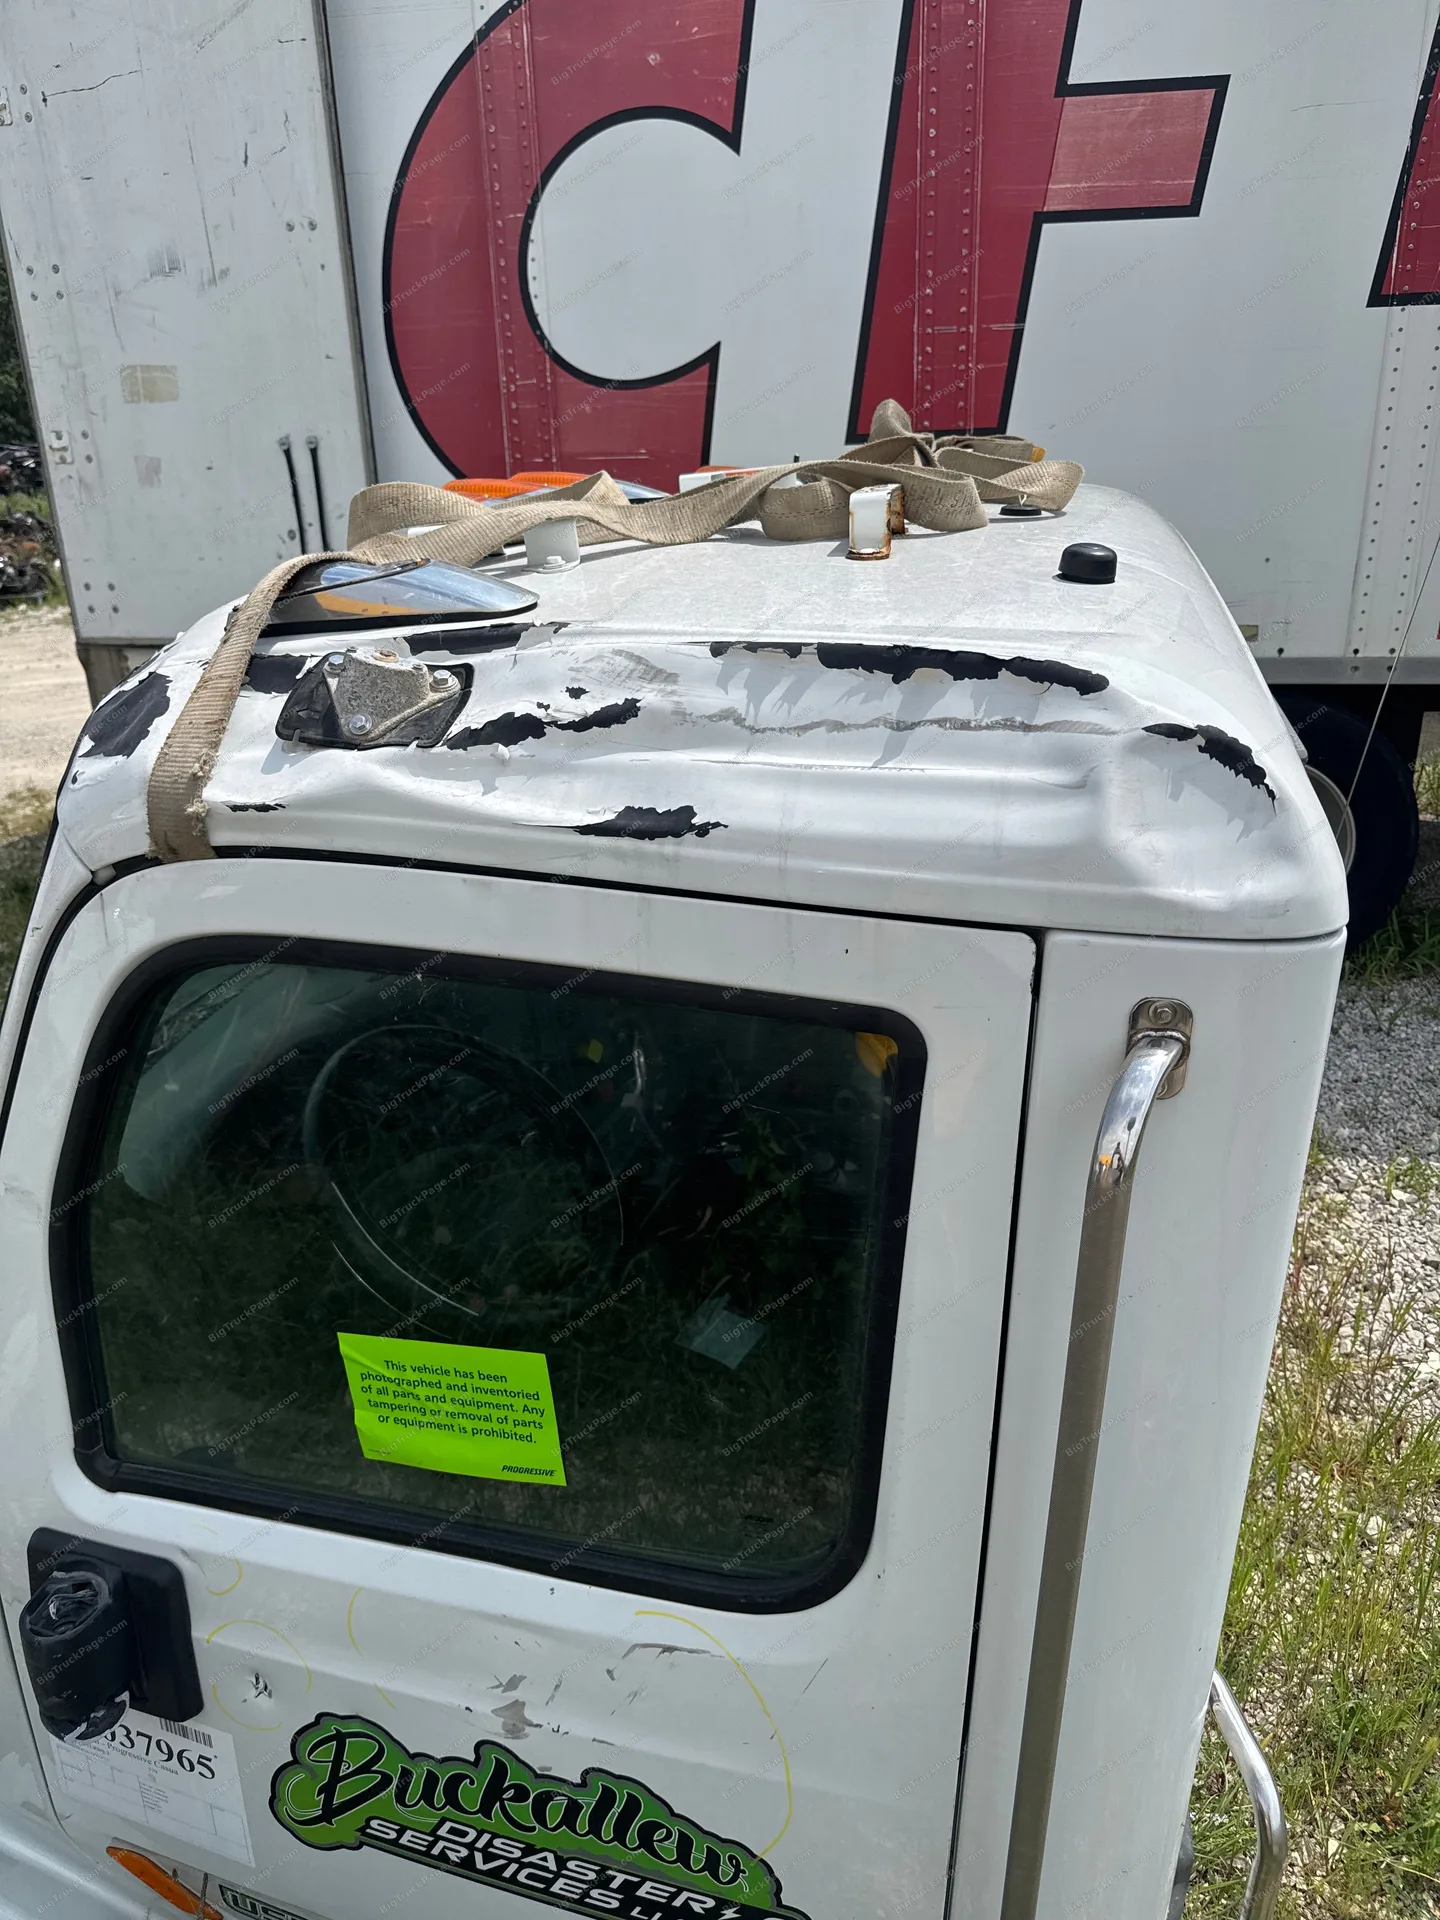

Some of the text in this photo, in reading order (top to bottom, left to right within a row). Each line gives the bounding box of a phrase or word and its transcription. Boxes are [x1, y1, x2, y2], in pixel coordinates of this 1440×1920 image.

[360, 1371, 540, 1401] photographed and inventoried
[383, 1360, 508, 1383] This vehicle has been
[361, 1384, 545, 1418] of all parts and equipment. Any
[368, 1399, 543, 1429] tampering or removal of parts
[378, 1415, 537, 1444] or equipment is prohibited.
[502, 1465, 555, 1476] PROGRESSIVE
[285, 1726, 749, 1893] Buckallew
[365, 1818, 625, 1909] SERVICES
[436, 1820, 716, 1914] DISASTER
